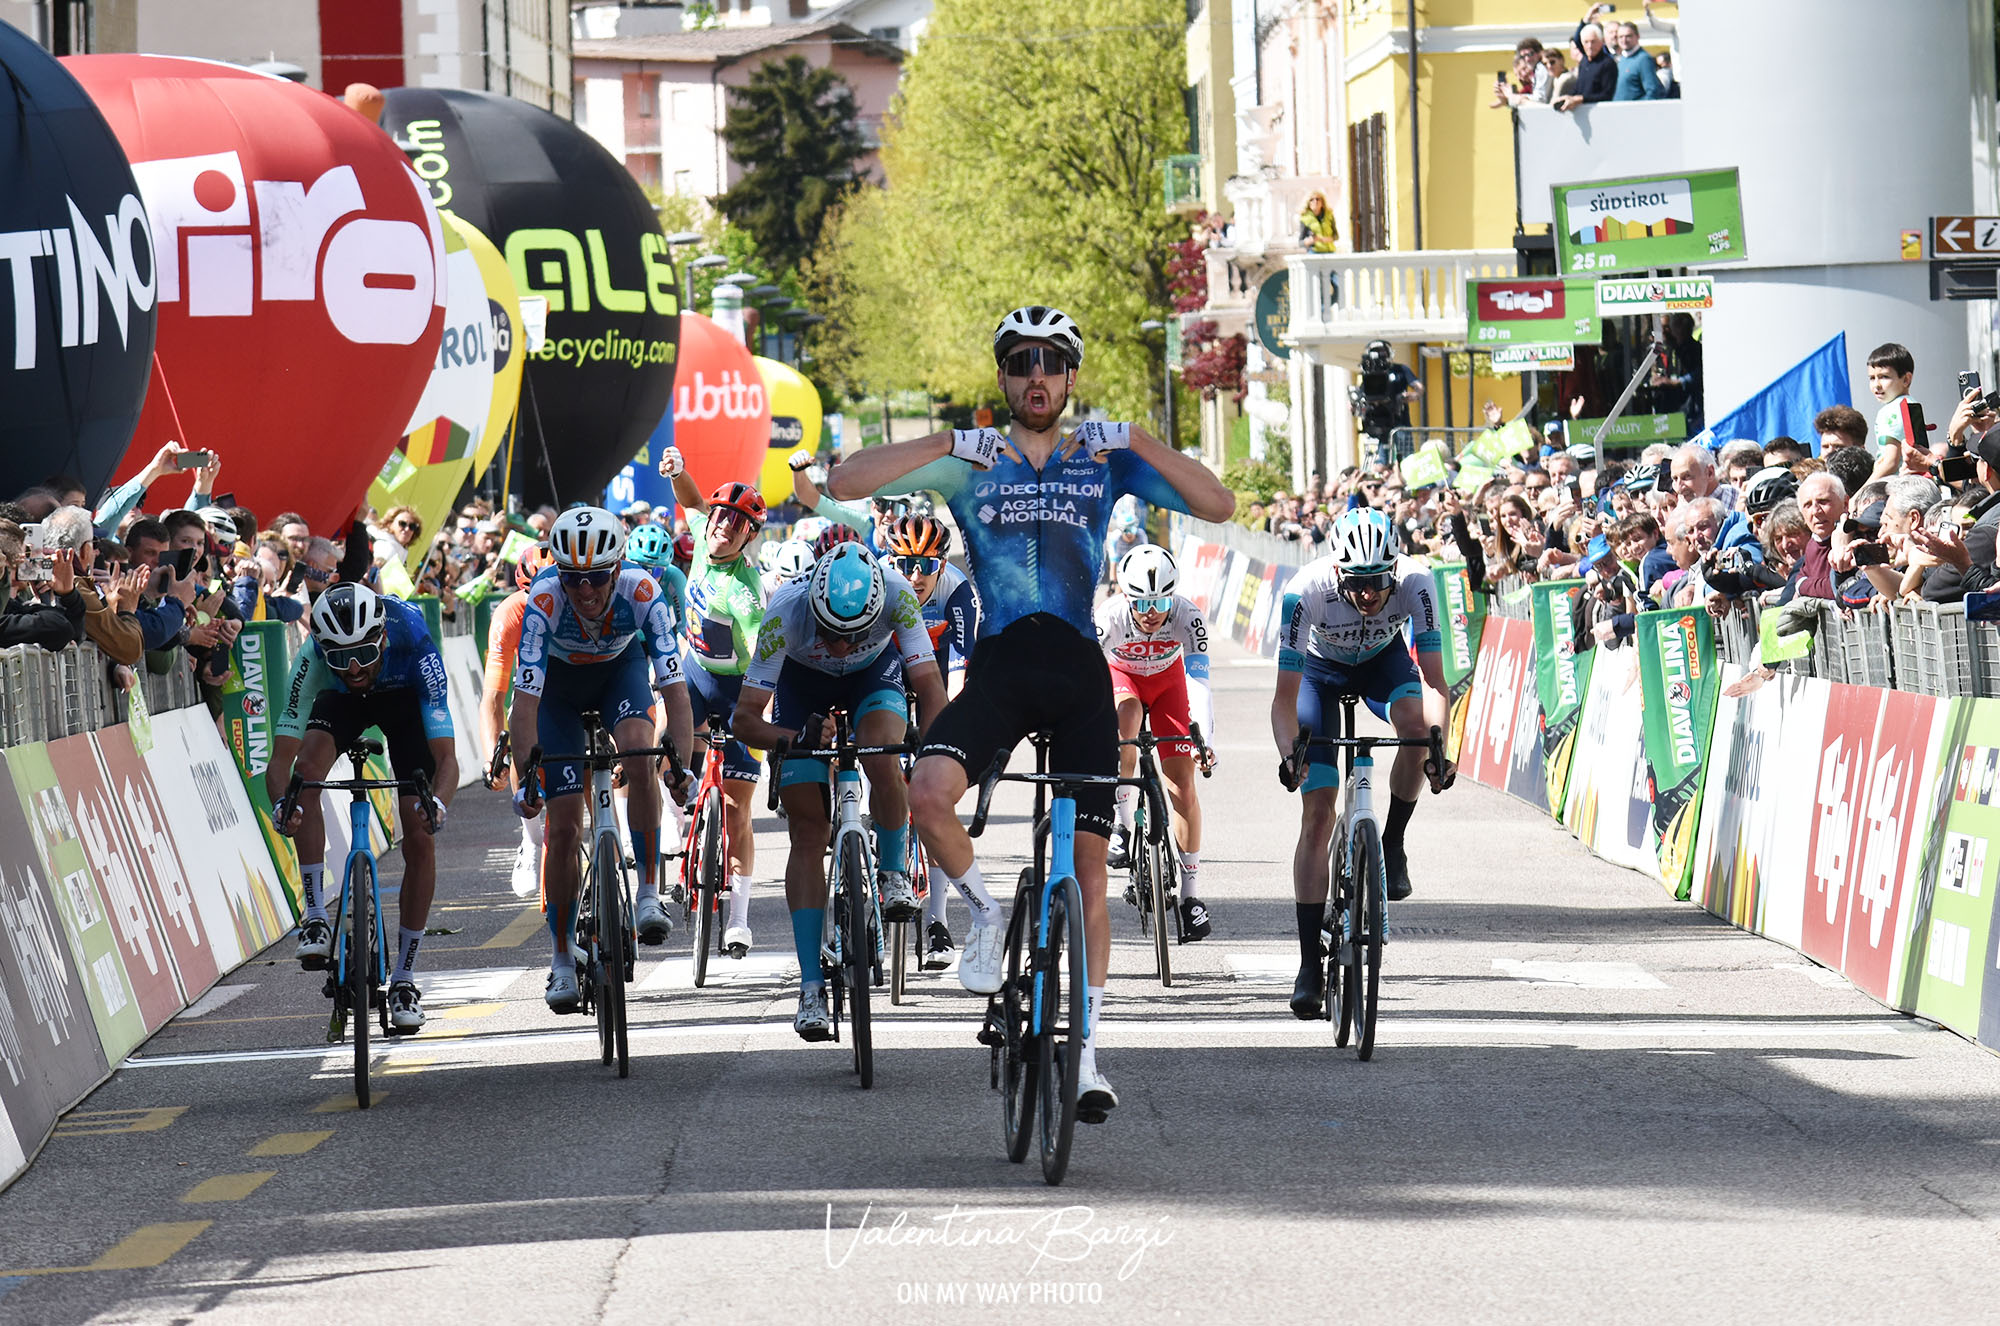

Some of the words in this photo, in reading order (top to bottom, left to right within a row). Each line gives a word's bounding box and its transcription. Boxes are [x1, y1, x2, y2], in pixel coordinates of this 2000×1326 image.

[1572, 253, 1596, 270] 25
[1599, 253, 1617, 267] m
[1478, 326, 1499, 340] 50
[1501, 329, 1511, 339] m
[1581, 422, 1641, 438] HOSITALITY
[1000, 482, 1105, 498] DECATHLON
[1000, 499, 1047, 512] AG2R
[1052, 499, 1077, 513] LA
[1000, 509, 1089, 529] MONDIALE
[952, 606, 965, 648] GIANT
[1289, 600, 1304, 650] MERIDA
[1418, 588, 1434, 632] MERIDA
[1191, 617, 1208, 652] solo
[1687, 631, 1700, 677] FUOCO
[289, 656, 311, 699] DECATHLON
[403, 938, 420, 972] DECATHLON
